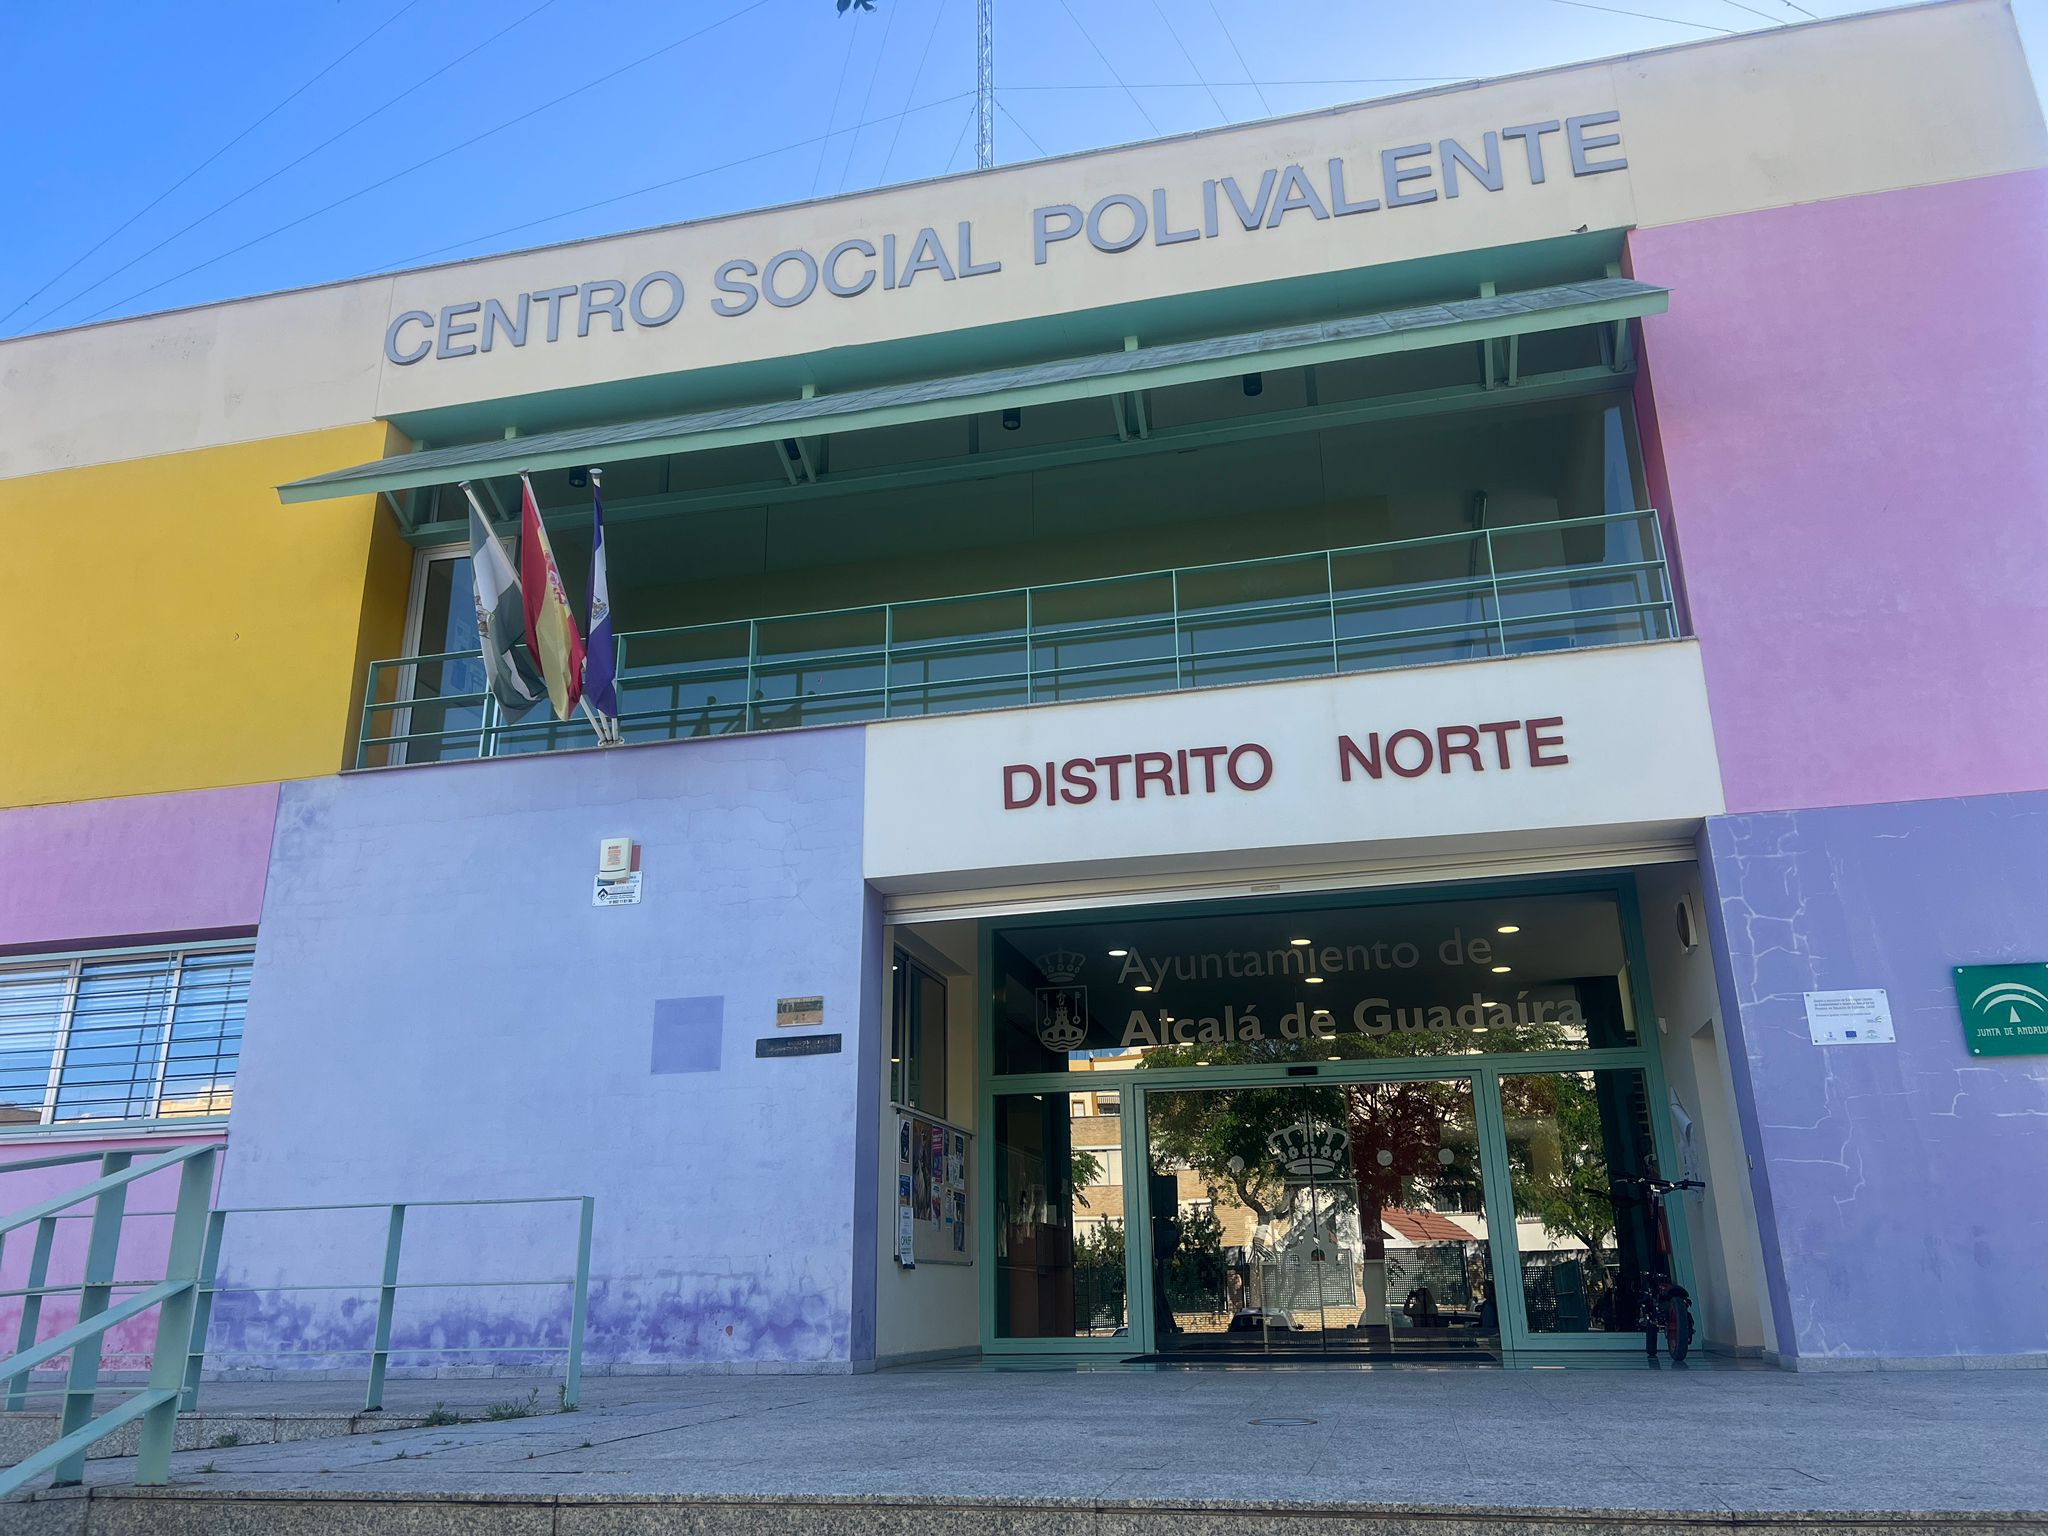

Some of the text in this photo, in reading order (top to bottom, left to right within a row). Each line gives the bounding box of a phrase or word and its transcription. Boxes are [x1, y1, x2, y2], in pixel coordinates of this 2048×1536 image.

[384, 110, 1629, 366] CENTRO SOCIAL POLIVALENTE
[1003, 716, 1569, 810] DISTRITO NORTE
[1117, 927, 1494, 993] Ayuntamiento de
[1119, 990, 1588, 1048] Alcalá de Guadaíra
[1976, 1027, 2002, 1037] JUNTA
[2003, 1026, 2015, 1036] DE
